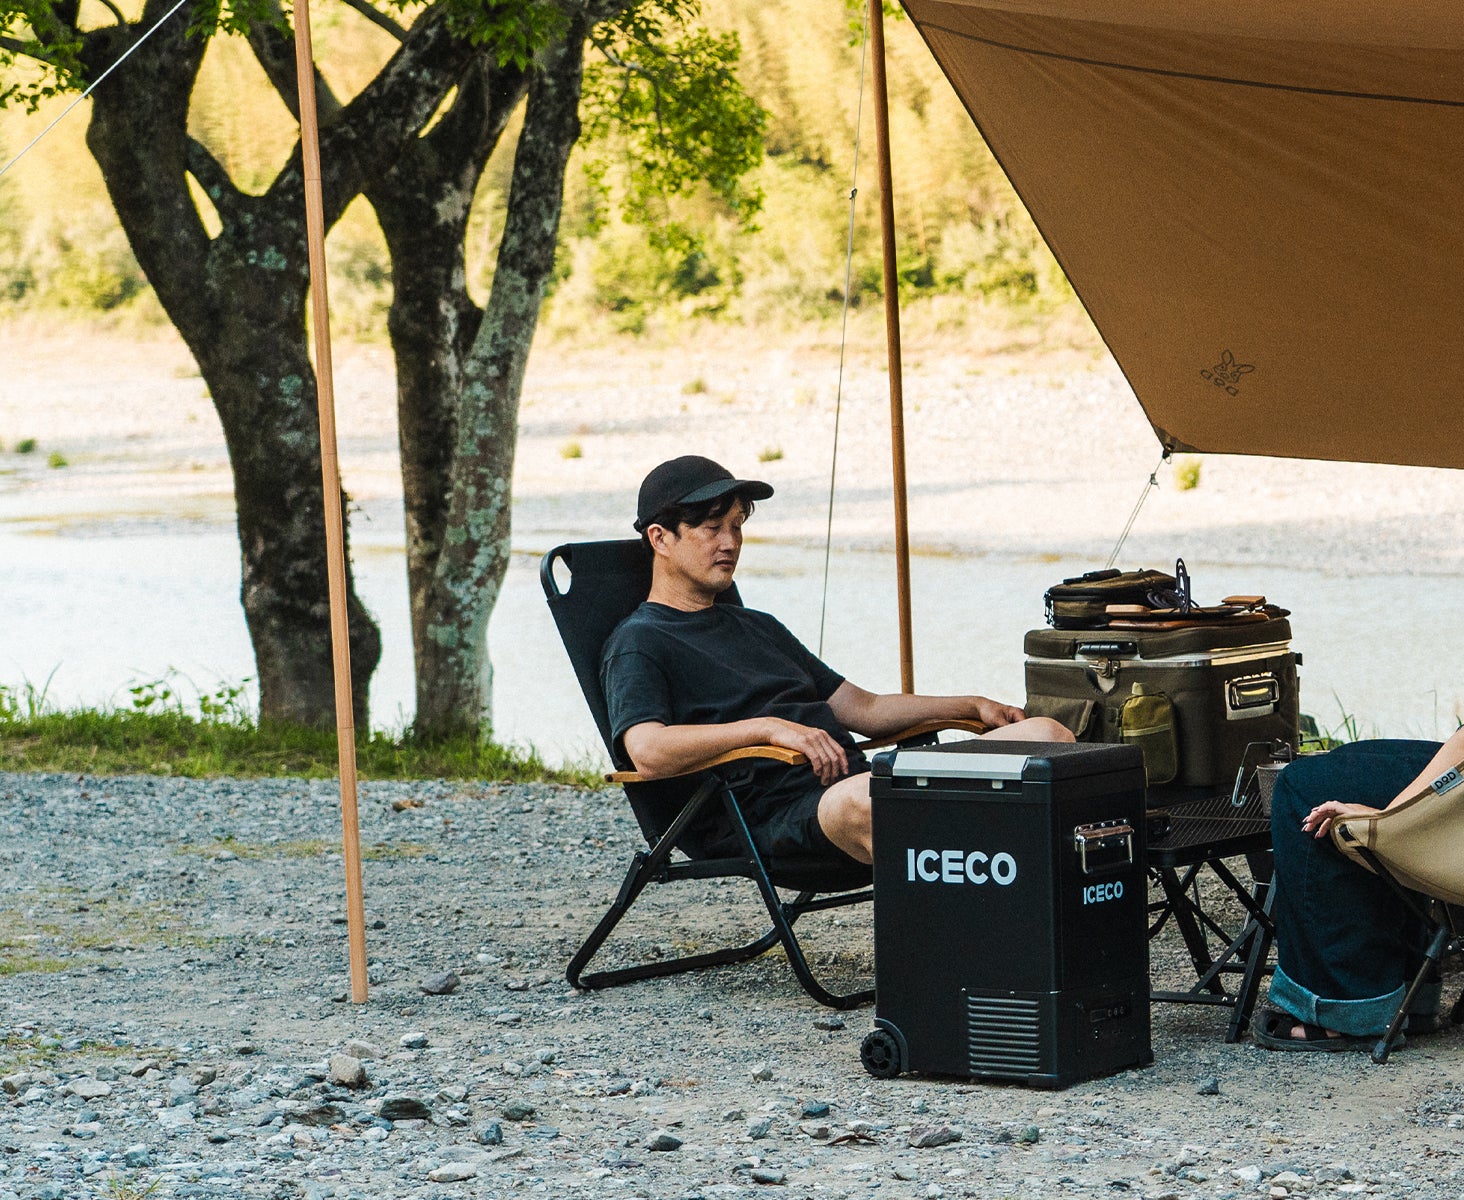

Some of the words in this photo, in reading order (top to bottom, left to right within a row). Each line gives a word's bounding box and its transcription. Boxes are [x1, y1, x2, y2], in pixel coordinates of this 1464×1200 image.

[1434, 771, 1456, 789] DOD
[907, 848, 1017, 886] ICECO
[1083, 881, 1124, 905] ICECO
